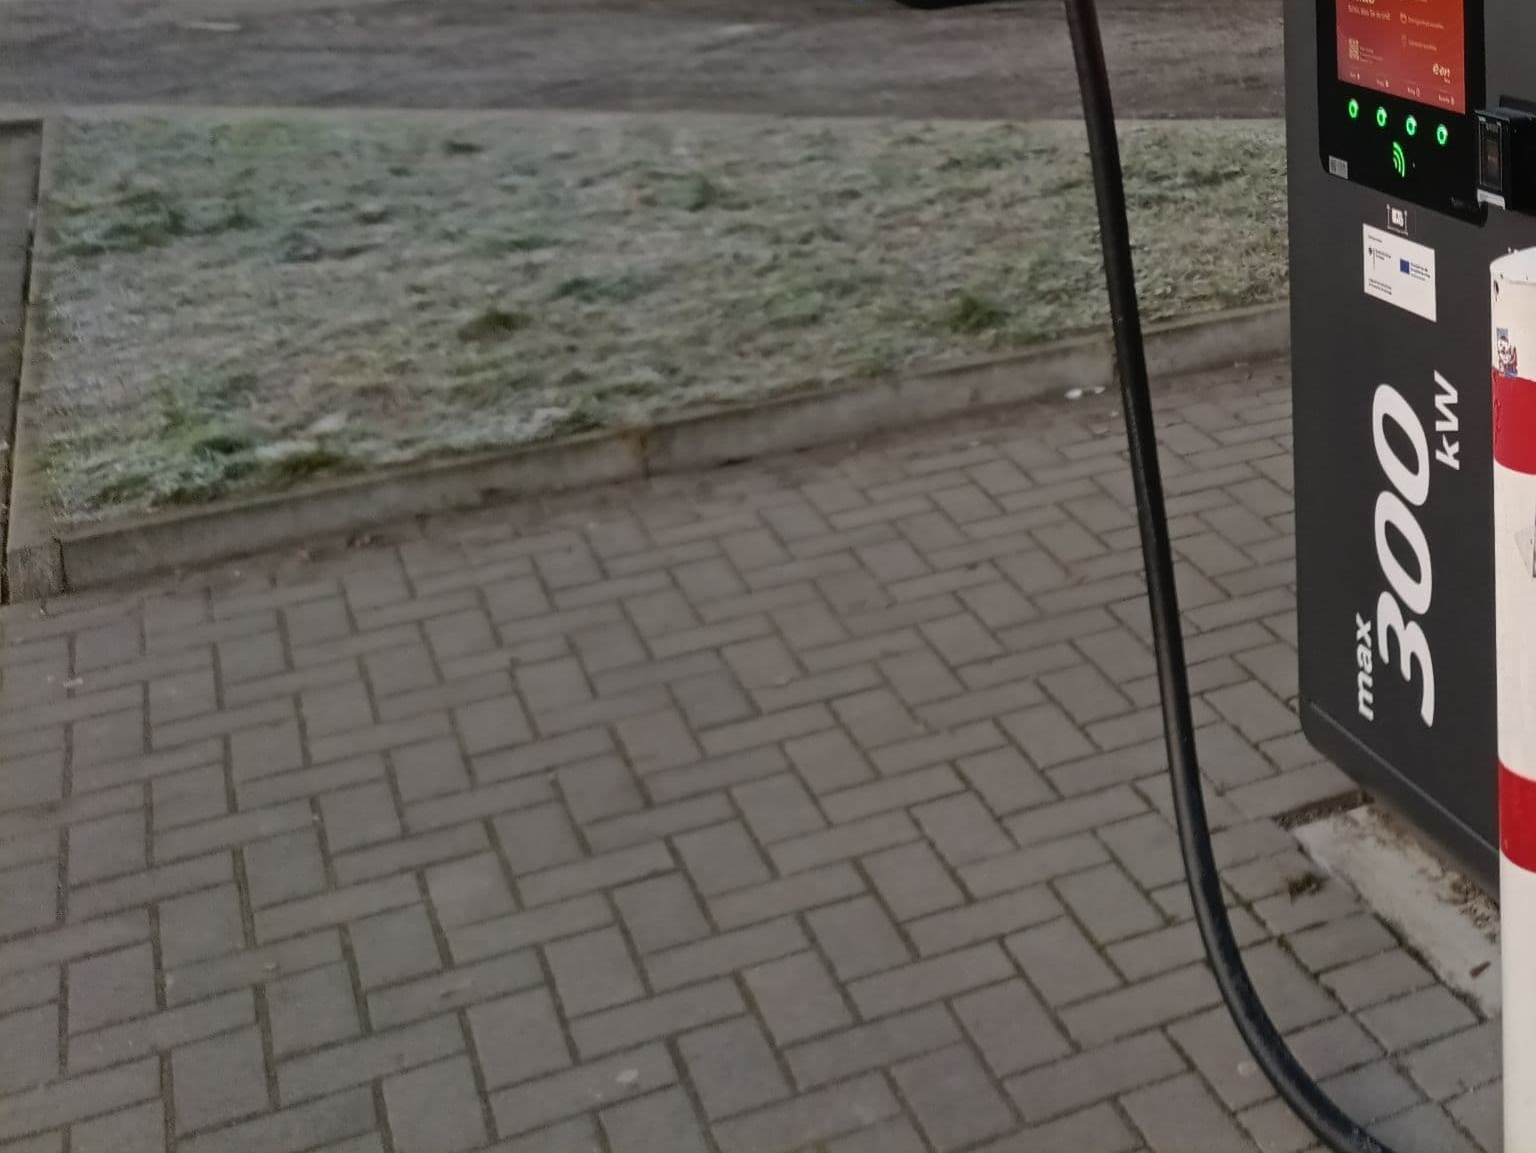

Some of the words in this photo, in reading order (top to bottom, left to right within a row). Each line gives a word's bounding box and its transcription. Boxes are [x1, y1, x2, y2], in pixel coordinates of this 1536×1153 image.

[1355, 613, 1375, 721] max
[1372, 383, 1436, 728] 300
[1433, 369, 1461, 471] kW
